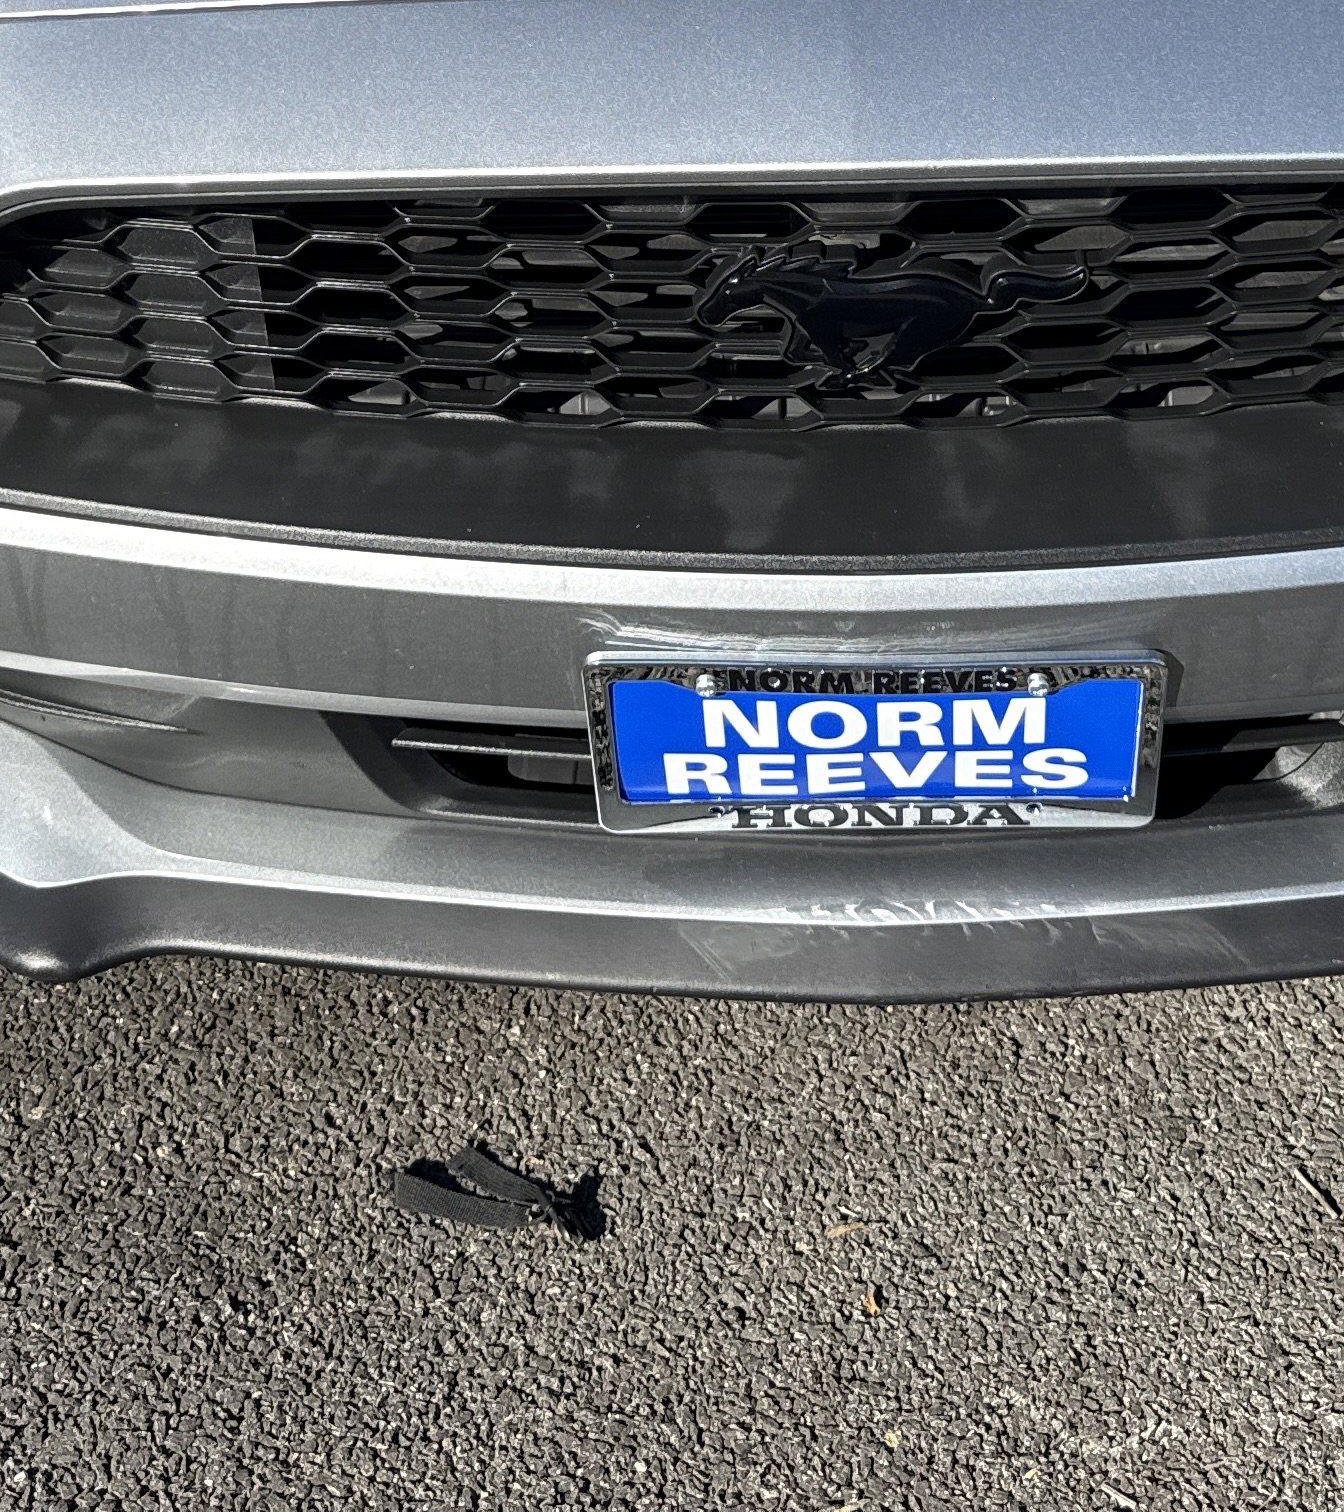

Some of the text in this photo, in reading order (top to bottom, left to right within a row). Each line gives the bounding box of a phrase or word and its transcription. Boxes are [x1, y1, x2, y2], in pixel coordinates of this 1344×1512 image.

[728, 669, 1017, 694] NORM REEVES
[702, 697, 1045, 749] NORM
[663, 749, 1088, 795] REEVES
[731, 804, 1031, 829] HONDA
